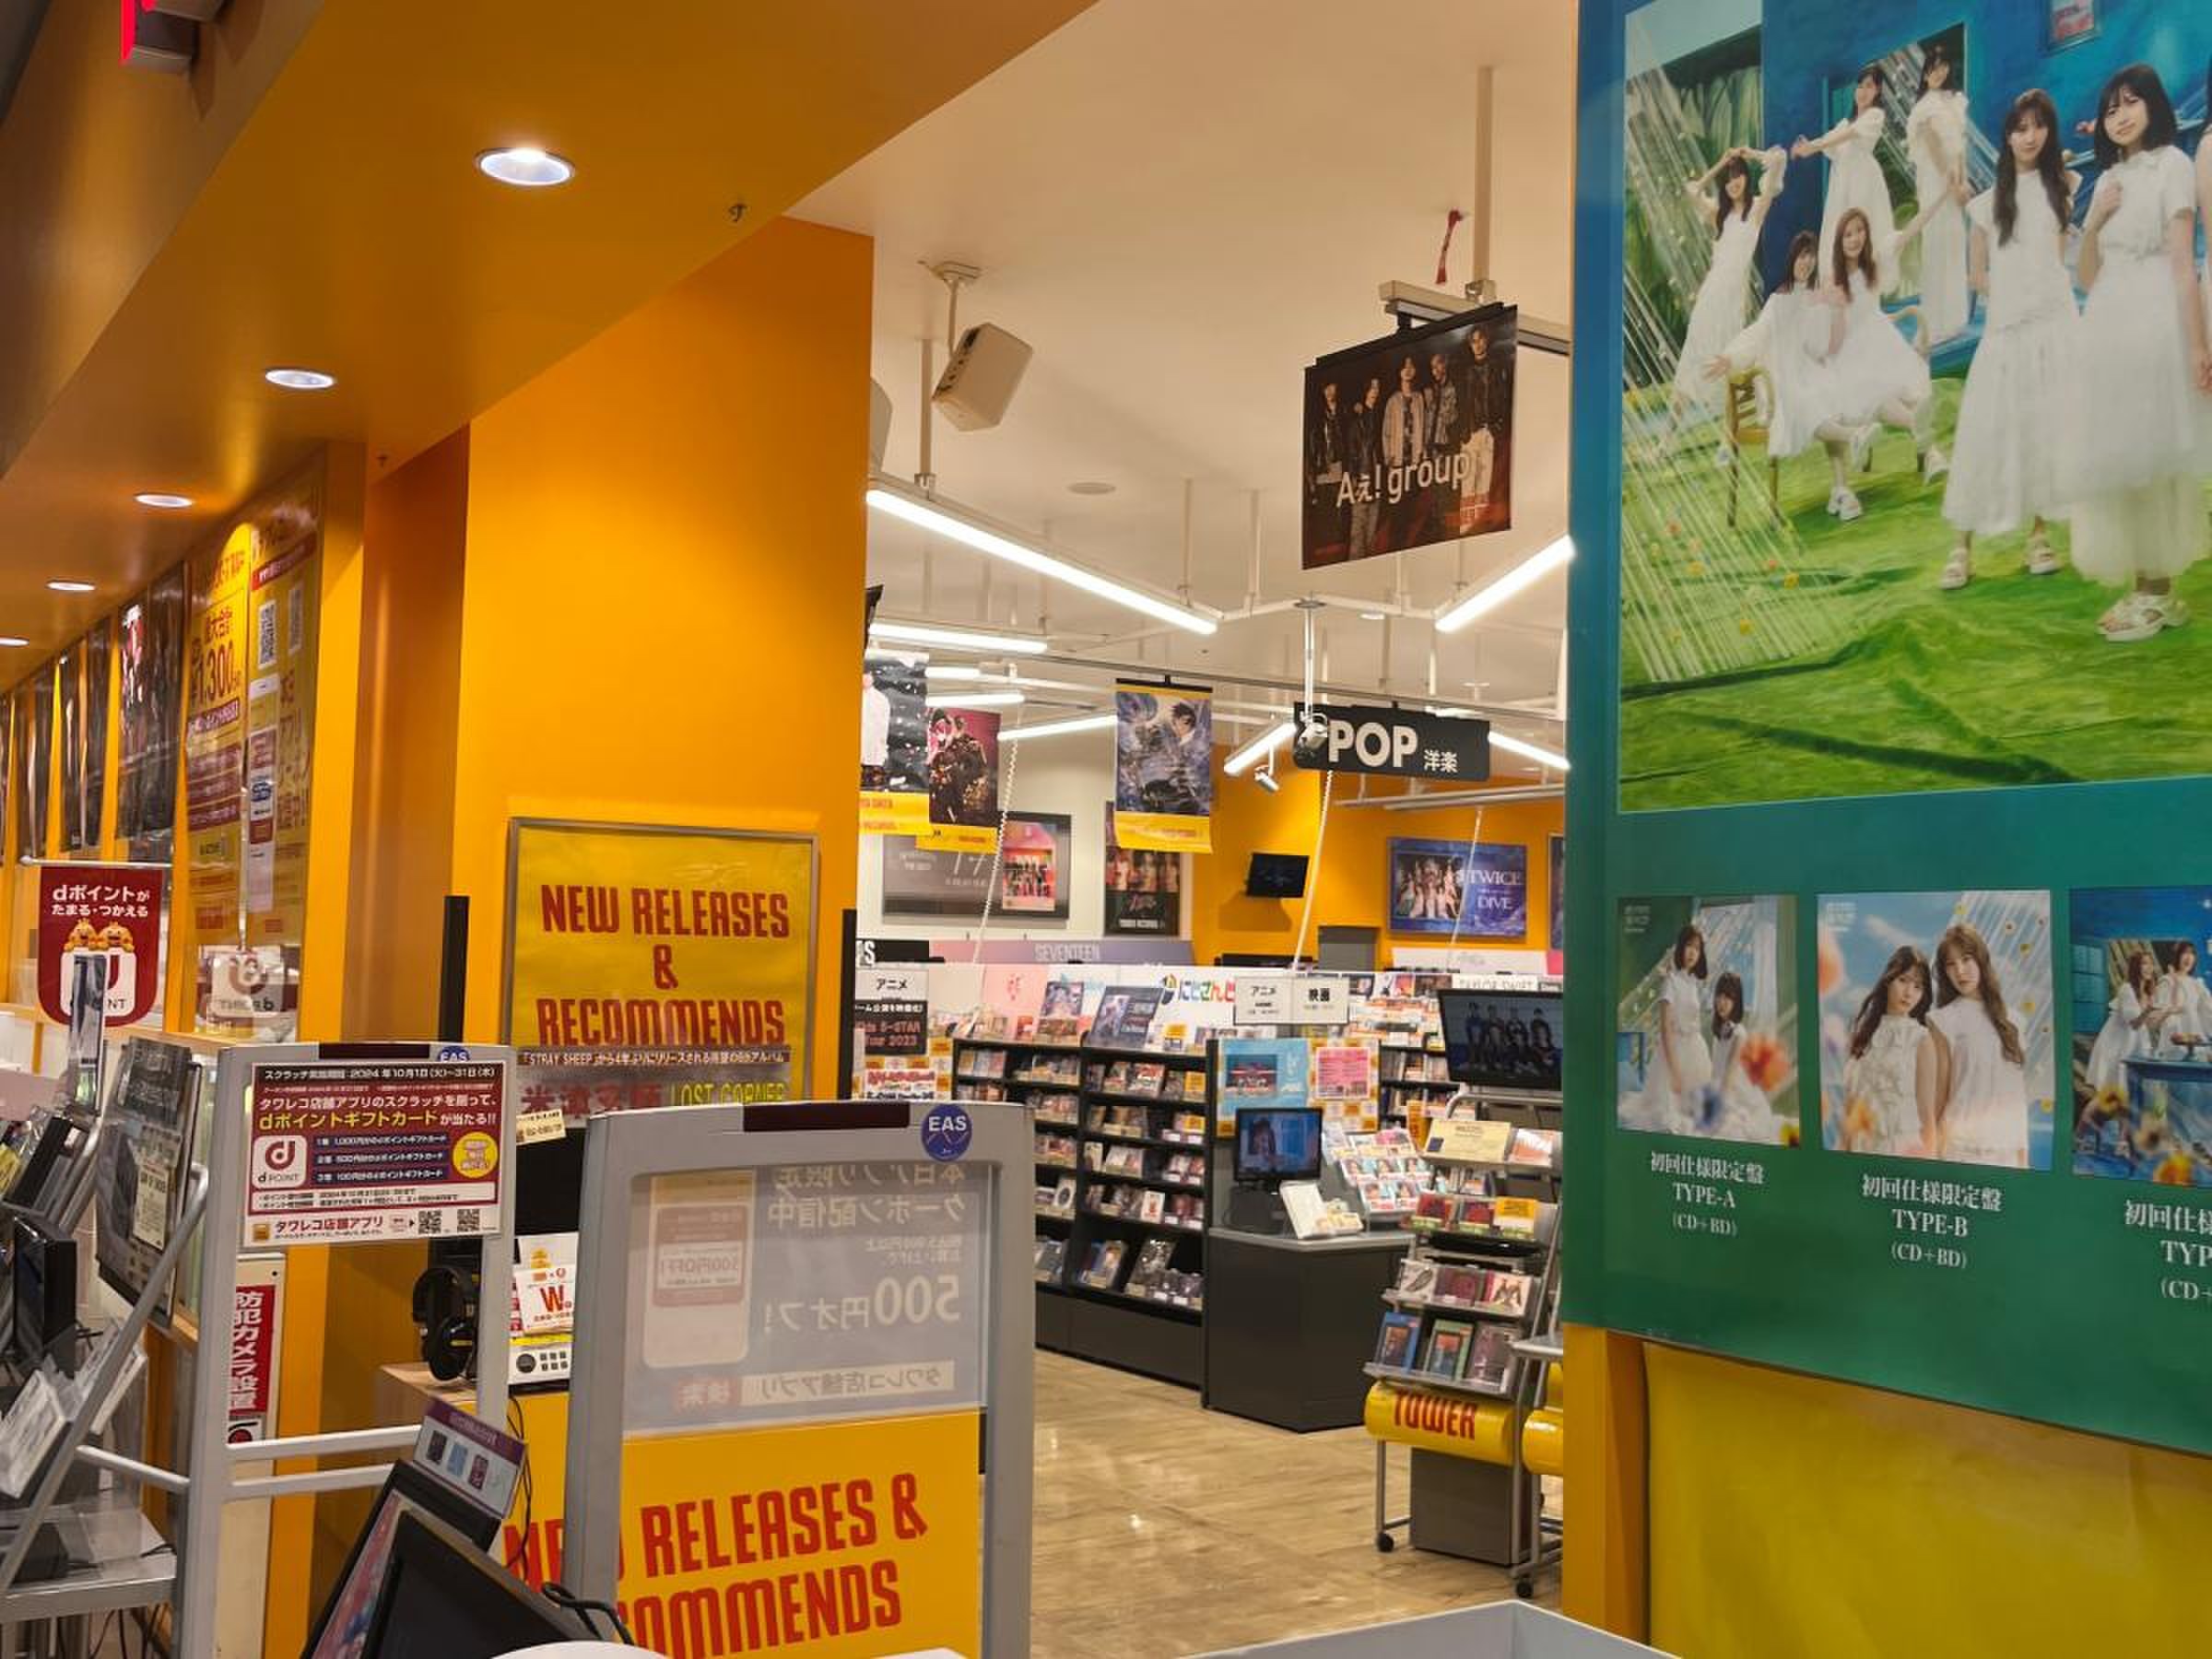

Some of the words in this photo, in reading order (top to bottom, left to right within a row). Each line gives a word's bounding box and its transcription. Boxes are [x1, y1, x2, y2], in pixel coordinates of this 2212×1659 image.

[1387, 453, 1471, 504] group
[1328, 720, 1418, 768] POP
[1423, 749, 1458, 772] 洋楽
[1467, 869, 1524, 886] TWICE
[52, 884, 149, 902] dポイントが
[1477, 896, 1514, 912] DIVE
[52, 903, 148, 917] たまる・つかえる
[541, 885, 620, 934] NEW
[631, 888, 790, 938] RELEASES
[653, 944, 679, 991] &
[877, 978, 908, 991] アニメ
[536, 998, 786, 1046] RECOMMENDS
[929, 1115, 967, 1132] EAS
[1651, 1150, 1764, 1184] 初回仕様限定盤
[1672, 1182, 1736, 1208] TYPE-A
[1862, 1173, 2003, 1211] 初回仕様限定盤
[275, 1217, 383, 1233] タワレコ店舗アプリ
[1672, 1213, 1737, 1237] (CD+BD)
[1892, 1208, 1969, 1238] TYPE-B
[1891, 1241, 1968, 1269] (CD+BD)
[229, 1291, 265, 1409] 防犯カメラ設置
[1394, 1388, 1478, 1440] TOWER
[641, 1478, 877, 1579] RELEASES
[890, 1473, 928, 1540] &
